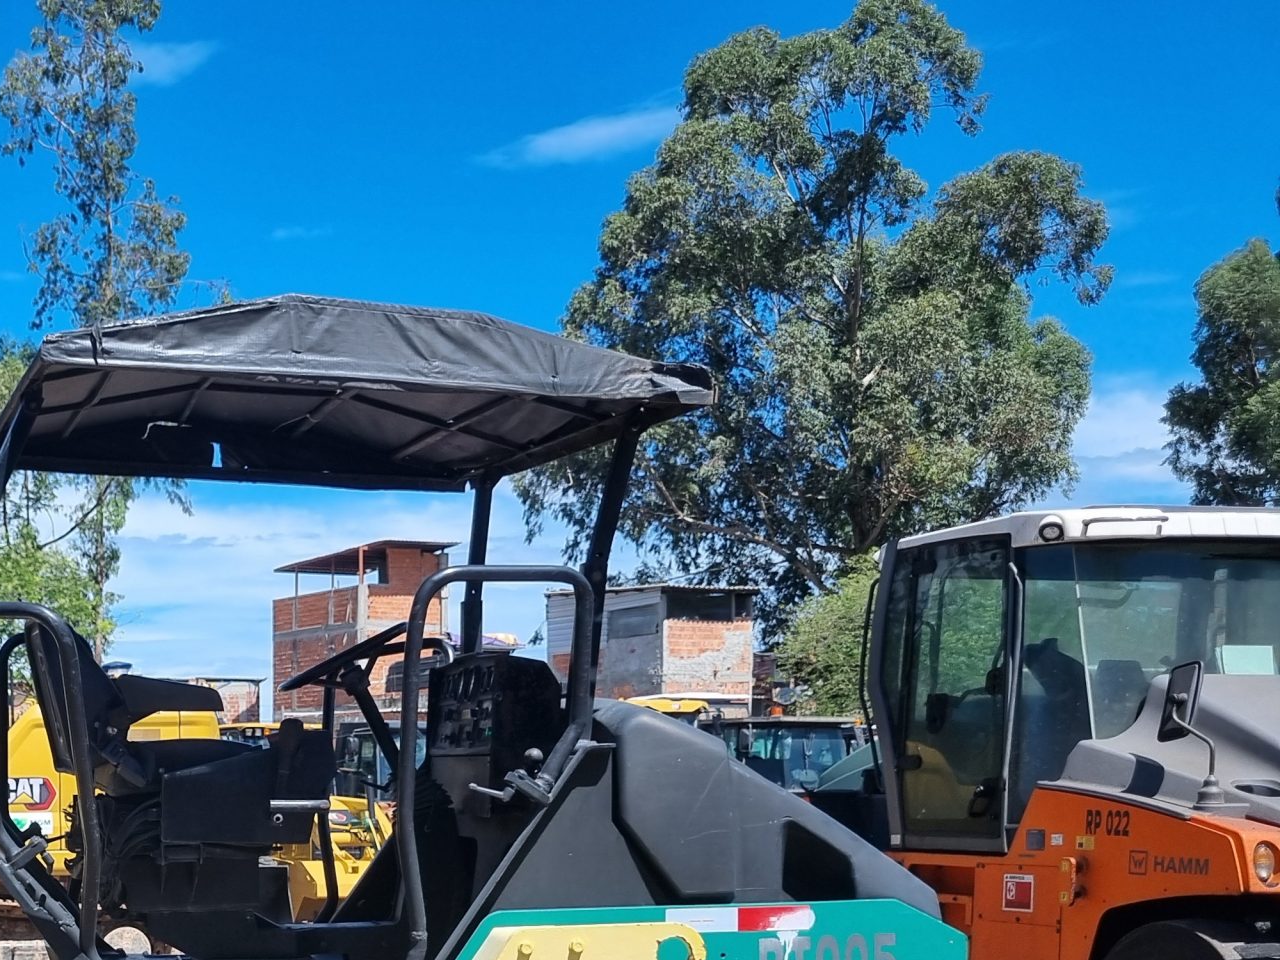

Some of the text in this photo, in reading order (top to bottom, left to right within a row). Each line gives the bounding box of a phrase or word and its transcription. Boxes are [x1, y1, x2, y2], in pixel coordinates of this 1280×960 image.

[1085, 809, 1130, 837] RP 022
[1153, 855, 1209, 875] HAMM
